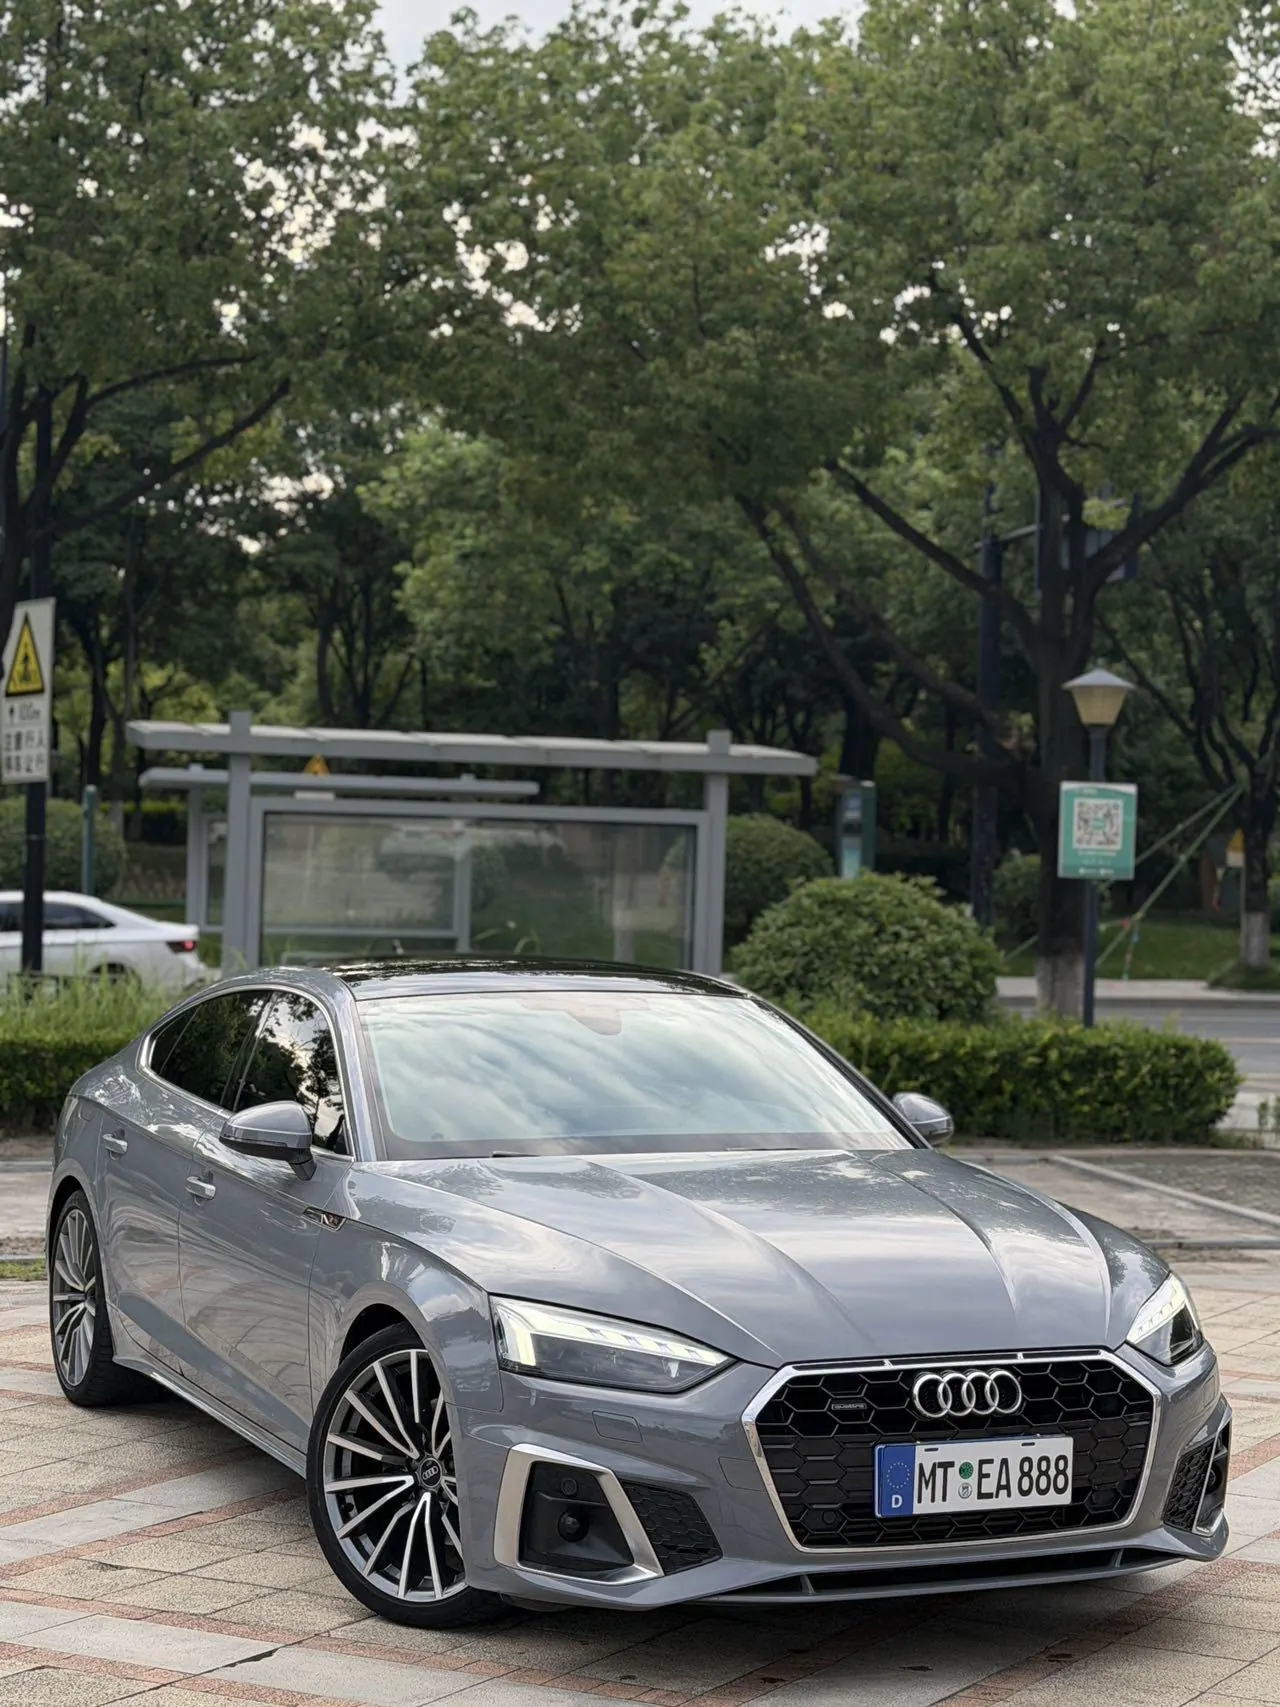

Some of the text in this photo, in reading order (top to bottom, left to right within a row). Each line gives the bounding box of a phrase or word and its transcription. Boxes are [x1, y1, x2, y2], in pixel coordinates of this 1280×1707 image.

[917, 1454, 1069, 1504] MT EA 888
[891, 1495, 903, 1508] D
